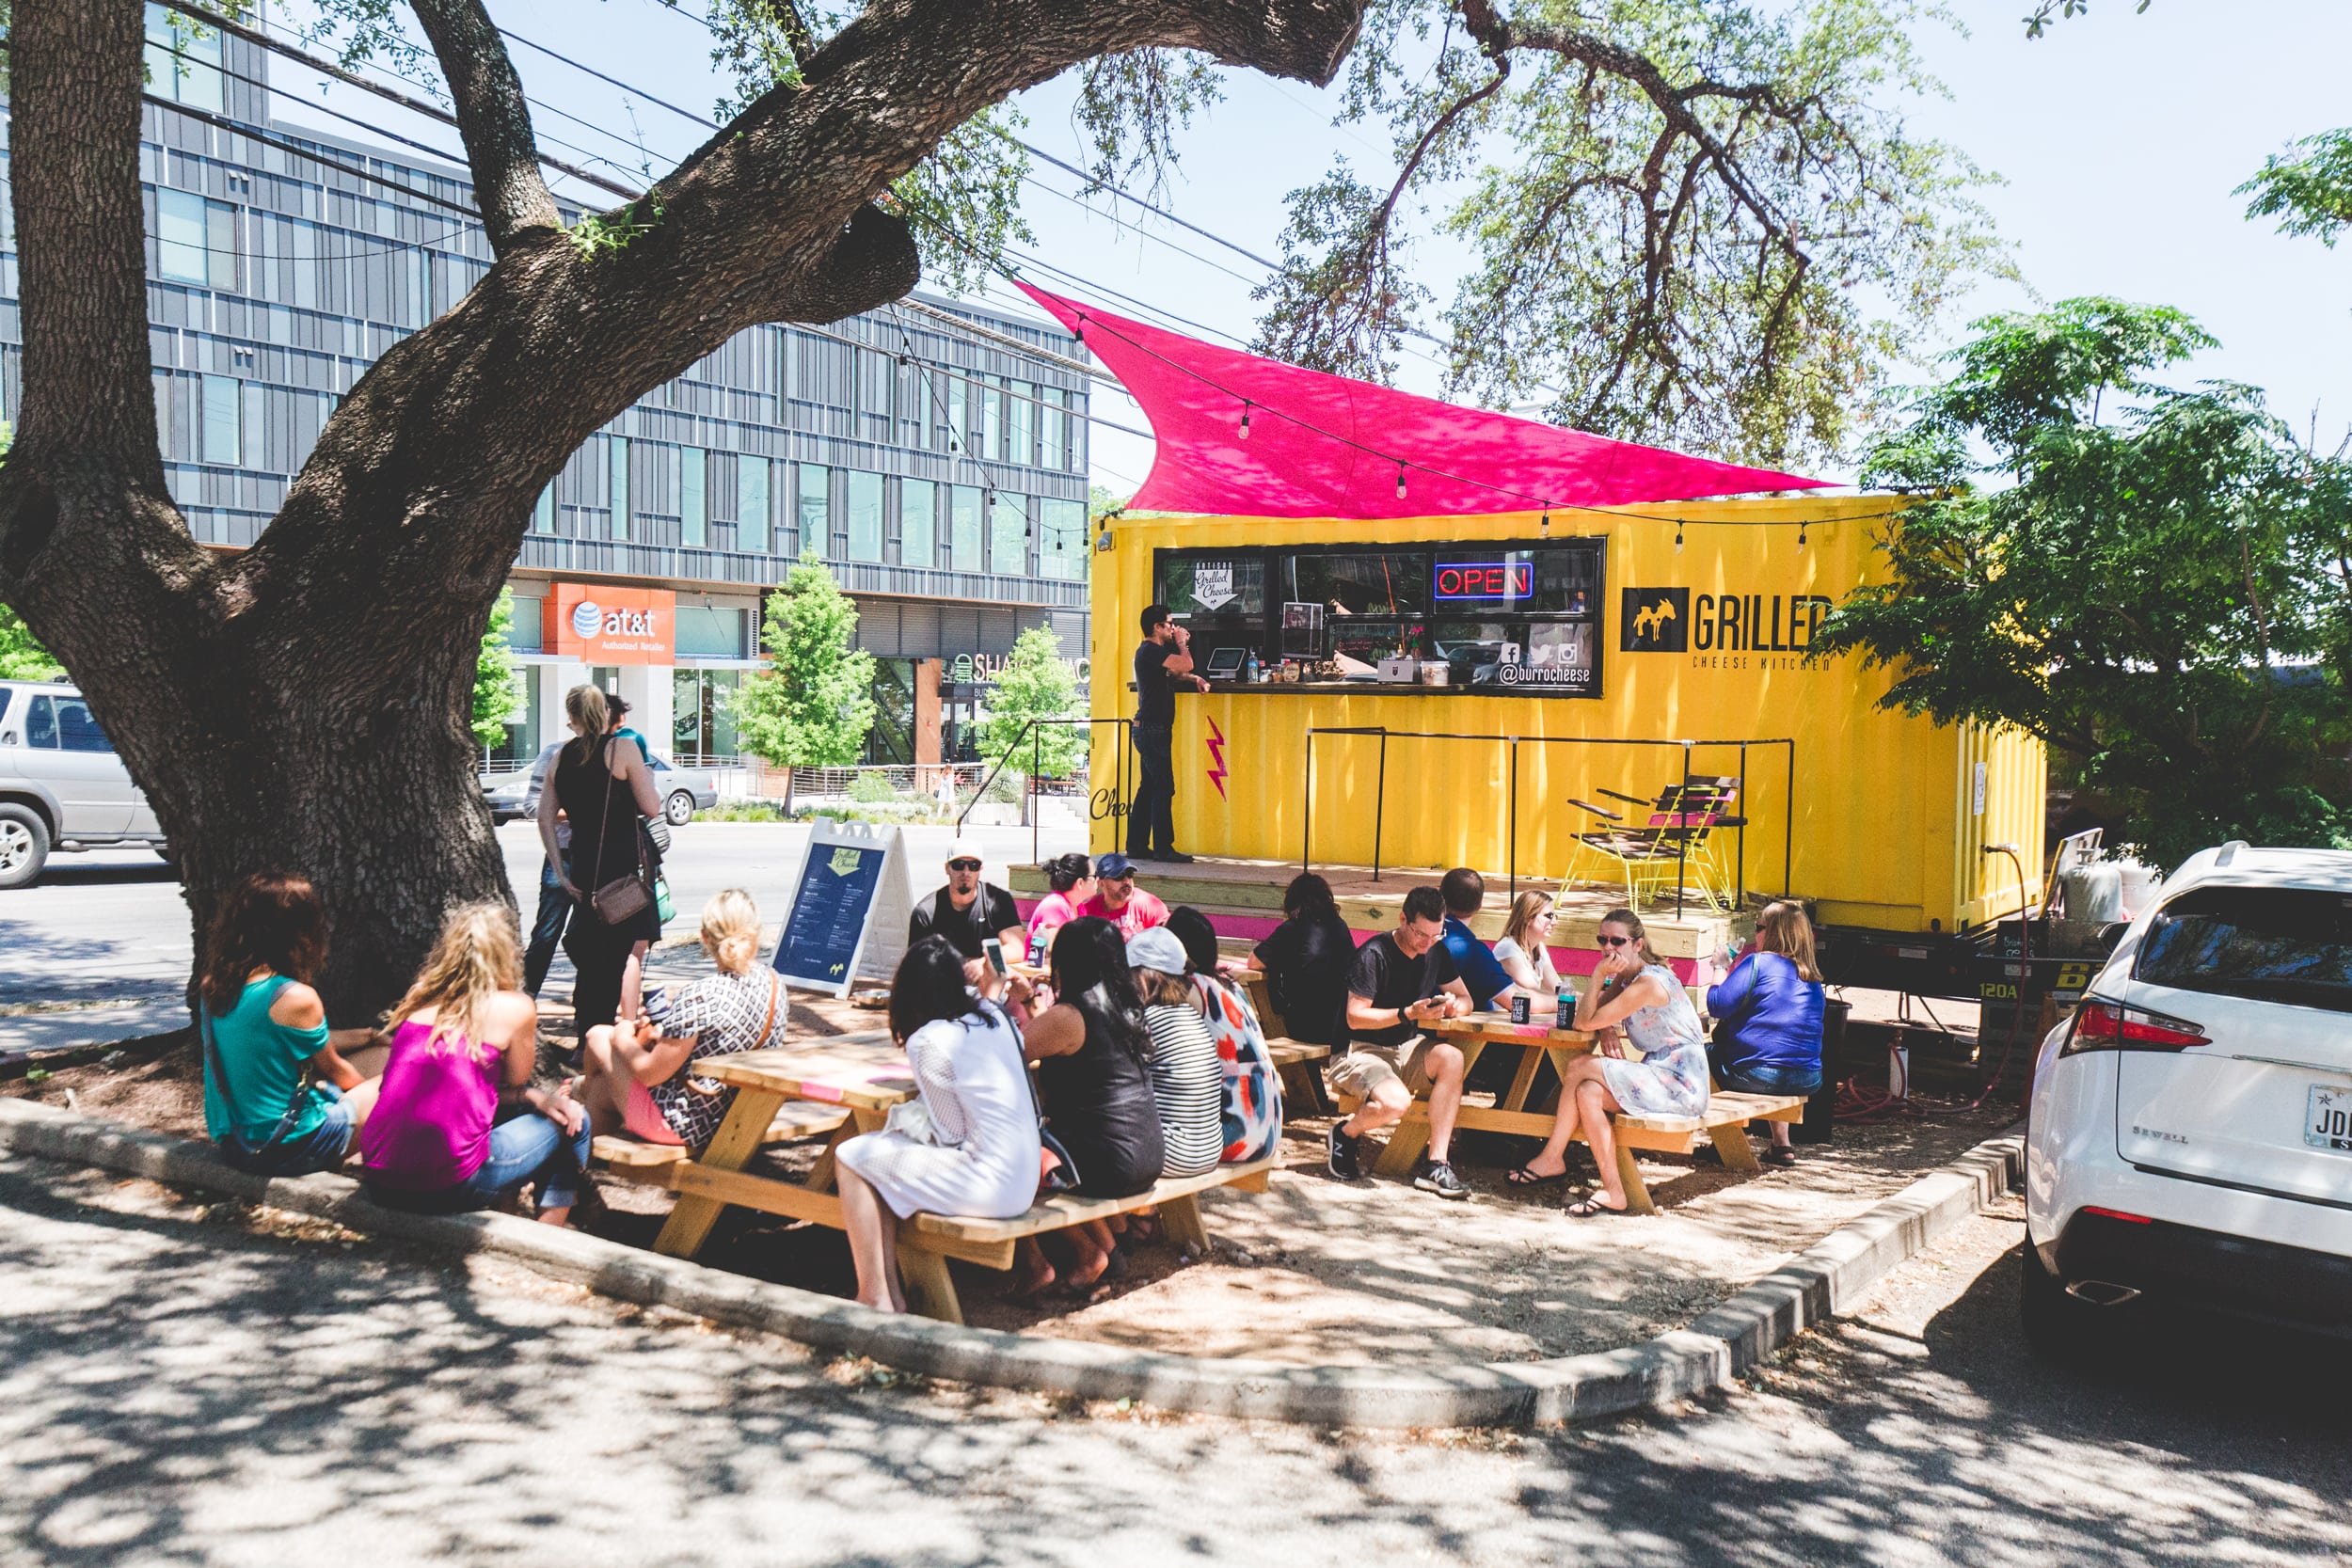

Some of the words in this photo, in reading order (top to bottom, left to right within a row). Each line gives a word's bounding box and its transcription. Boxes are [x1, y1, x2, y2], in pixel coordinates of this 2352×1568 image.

[1194, 570, 1229, 589] Grilled
[1438, 569, 1527, 594] OPEN
[1202, 584, 1232, 598] Cheese
[604, 607, 656, 638] at&t
[1692, 656, 1747, 669] CHEESE
[1760, 657, 1830, 671] KITCHEN
[1500, 664, 1590, 685] @burrocheese
[1979, 982, 2018, 1000] 120A
[2315, 1108, 2352, 1138] JD
[2132, 1126, 2189, 1145] SEWELL
